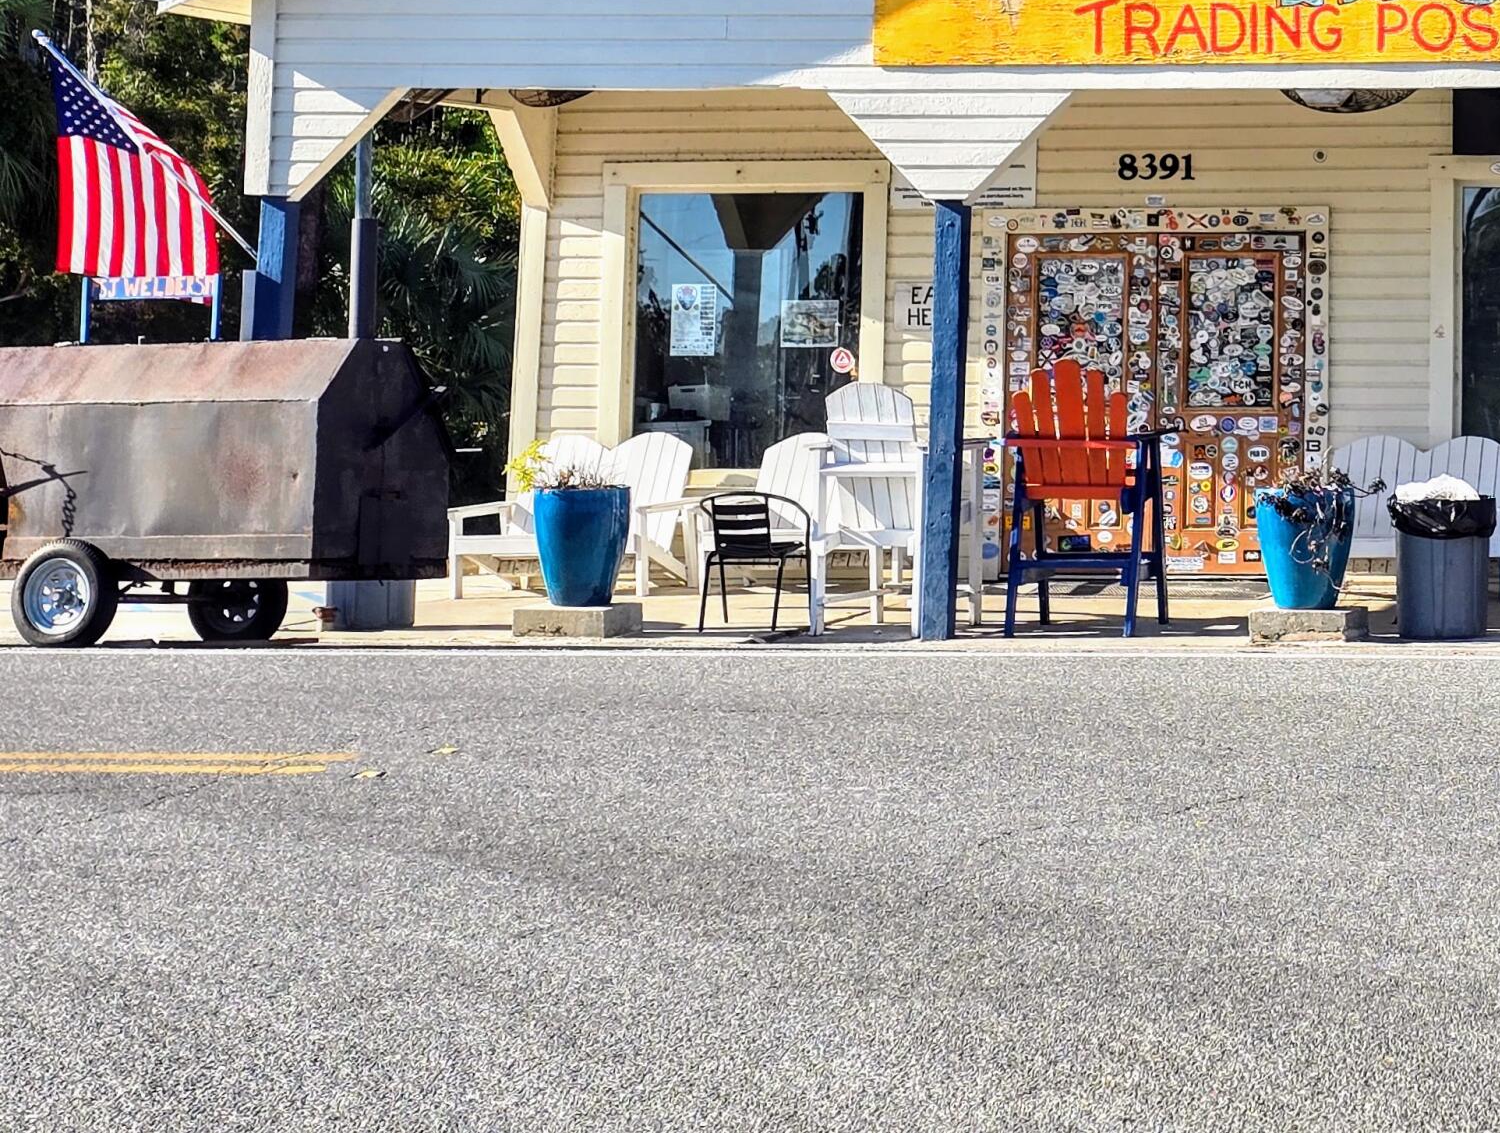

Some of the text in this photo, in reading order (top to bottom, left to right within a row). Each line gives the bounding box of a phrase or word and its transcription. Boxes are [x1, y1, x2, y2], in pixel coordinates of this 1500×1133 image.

[1117, 153, 1196, 181] 8391
[911, 286, 934, 305] EA
[907, 308, 932, 326] HE
